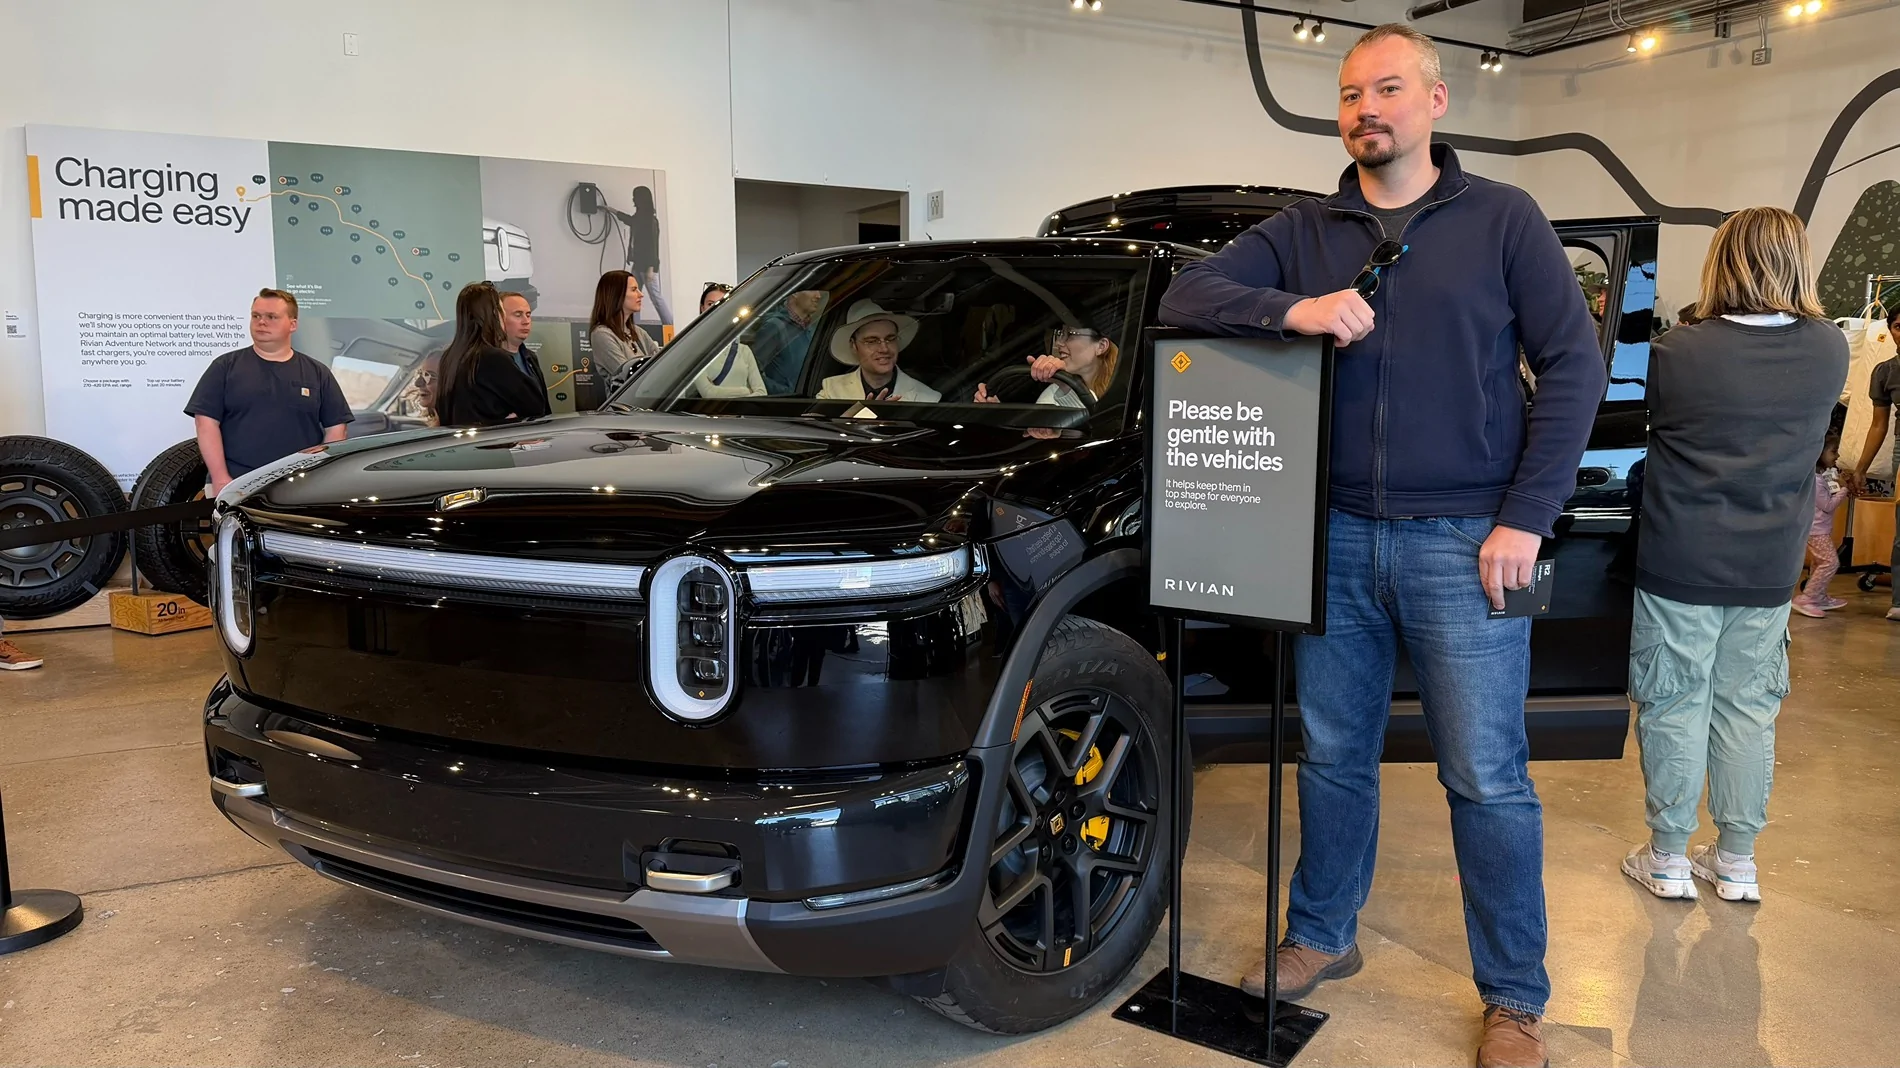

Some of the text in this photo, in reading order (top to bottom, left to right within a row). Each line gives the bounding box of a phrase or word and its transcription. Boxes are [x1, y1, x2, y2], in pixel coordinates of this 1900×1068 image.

[55, 156, 218, 200] Charging
[59, 194, 251, 233] made easy
[78, 312, 113, 320] Charging
[1168, 400, 1263, 421] Please be
[1167, 425, 1275, 447] gentle with
[1166, 447, 1283, 471] the vehicles
[1166, 479, 1251, 492] It helps keep them in
[1165, 489, 1261, 504] top shape for everyone
[1165, 499, 1208, 510] to explore.
[1544, 564, 1550, 575] R2
[1165, 579, 1234, 597] RIVIAN
